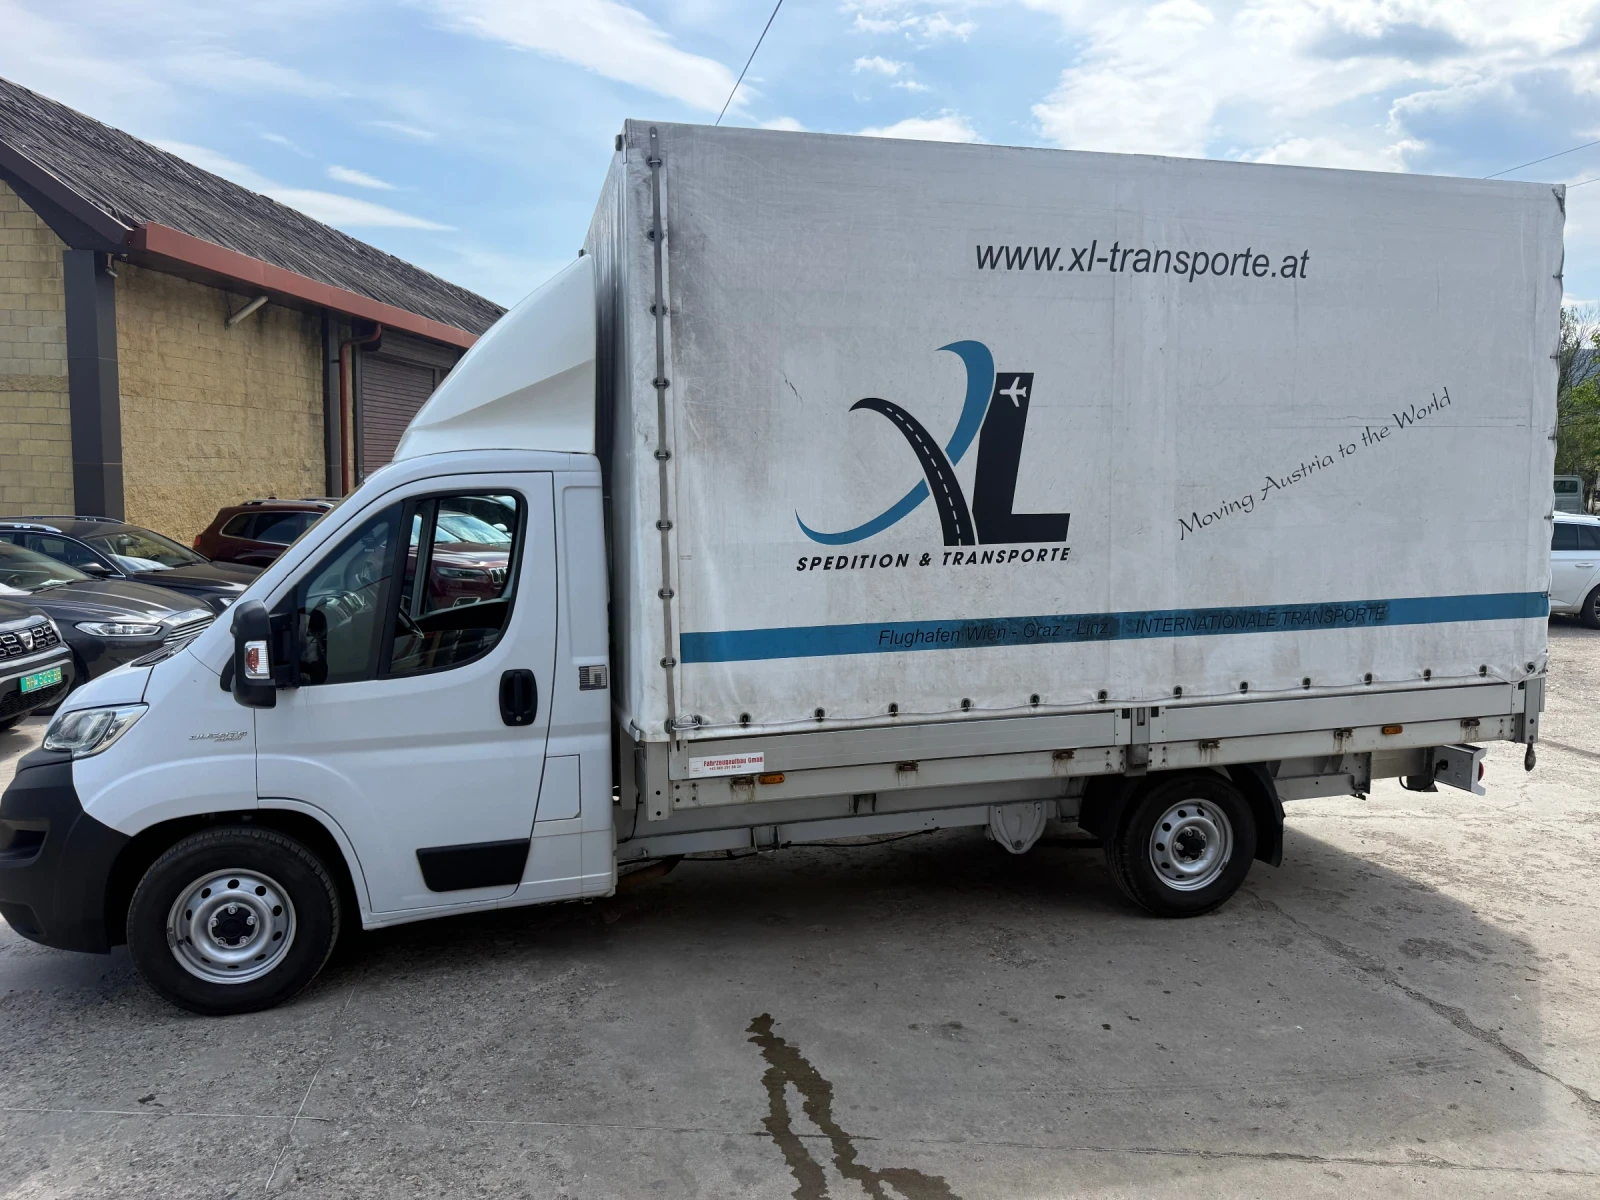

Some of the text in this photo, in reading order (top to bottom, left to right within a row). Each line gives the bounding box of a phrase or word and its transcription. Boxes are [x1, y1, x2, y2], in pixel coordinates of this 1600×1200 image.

[975, 240, 1310, 283] www.xl-transporte.at
[1178, 386, 1452, 541] Moving Austria to the World
[796, 547, 1071, 572] SPEDITION & TRANSPORTE
[878, 627, 960, 648] Flughafen
[966, 626, 1006, 642] Wien
[1023, 621, 1060, 639] Graz
[1076, 619, 1108, 637] Linz
[1135, 612, 1277, 634] INTERNATIONALE
[1281, 605, 1386, 627] TRANSPORTE
